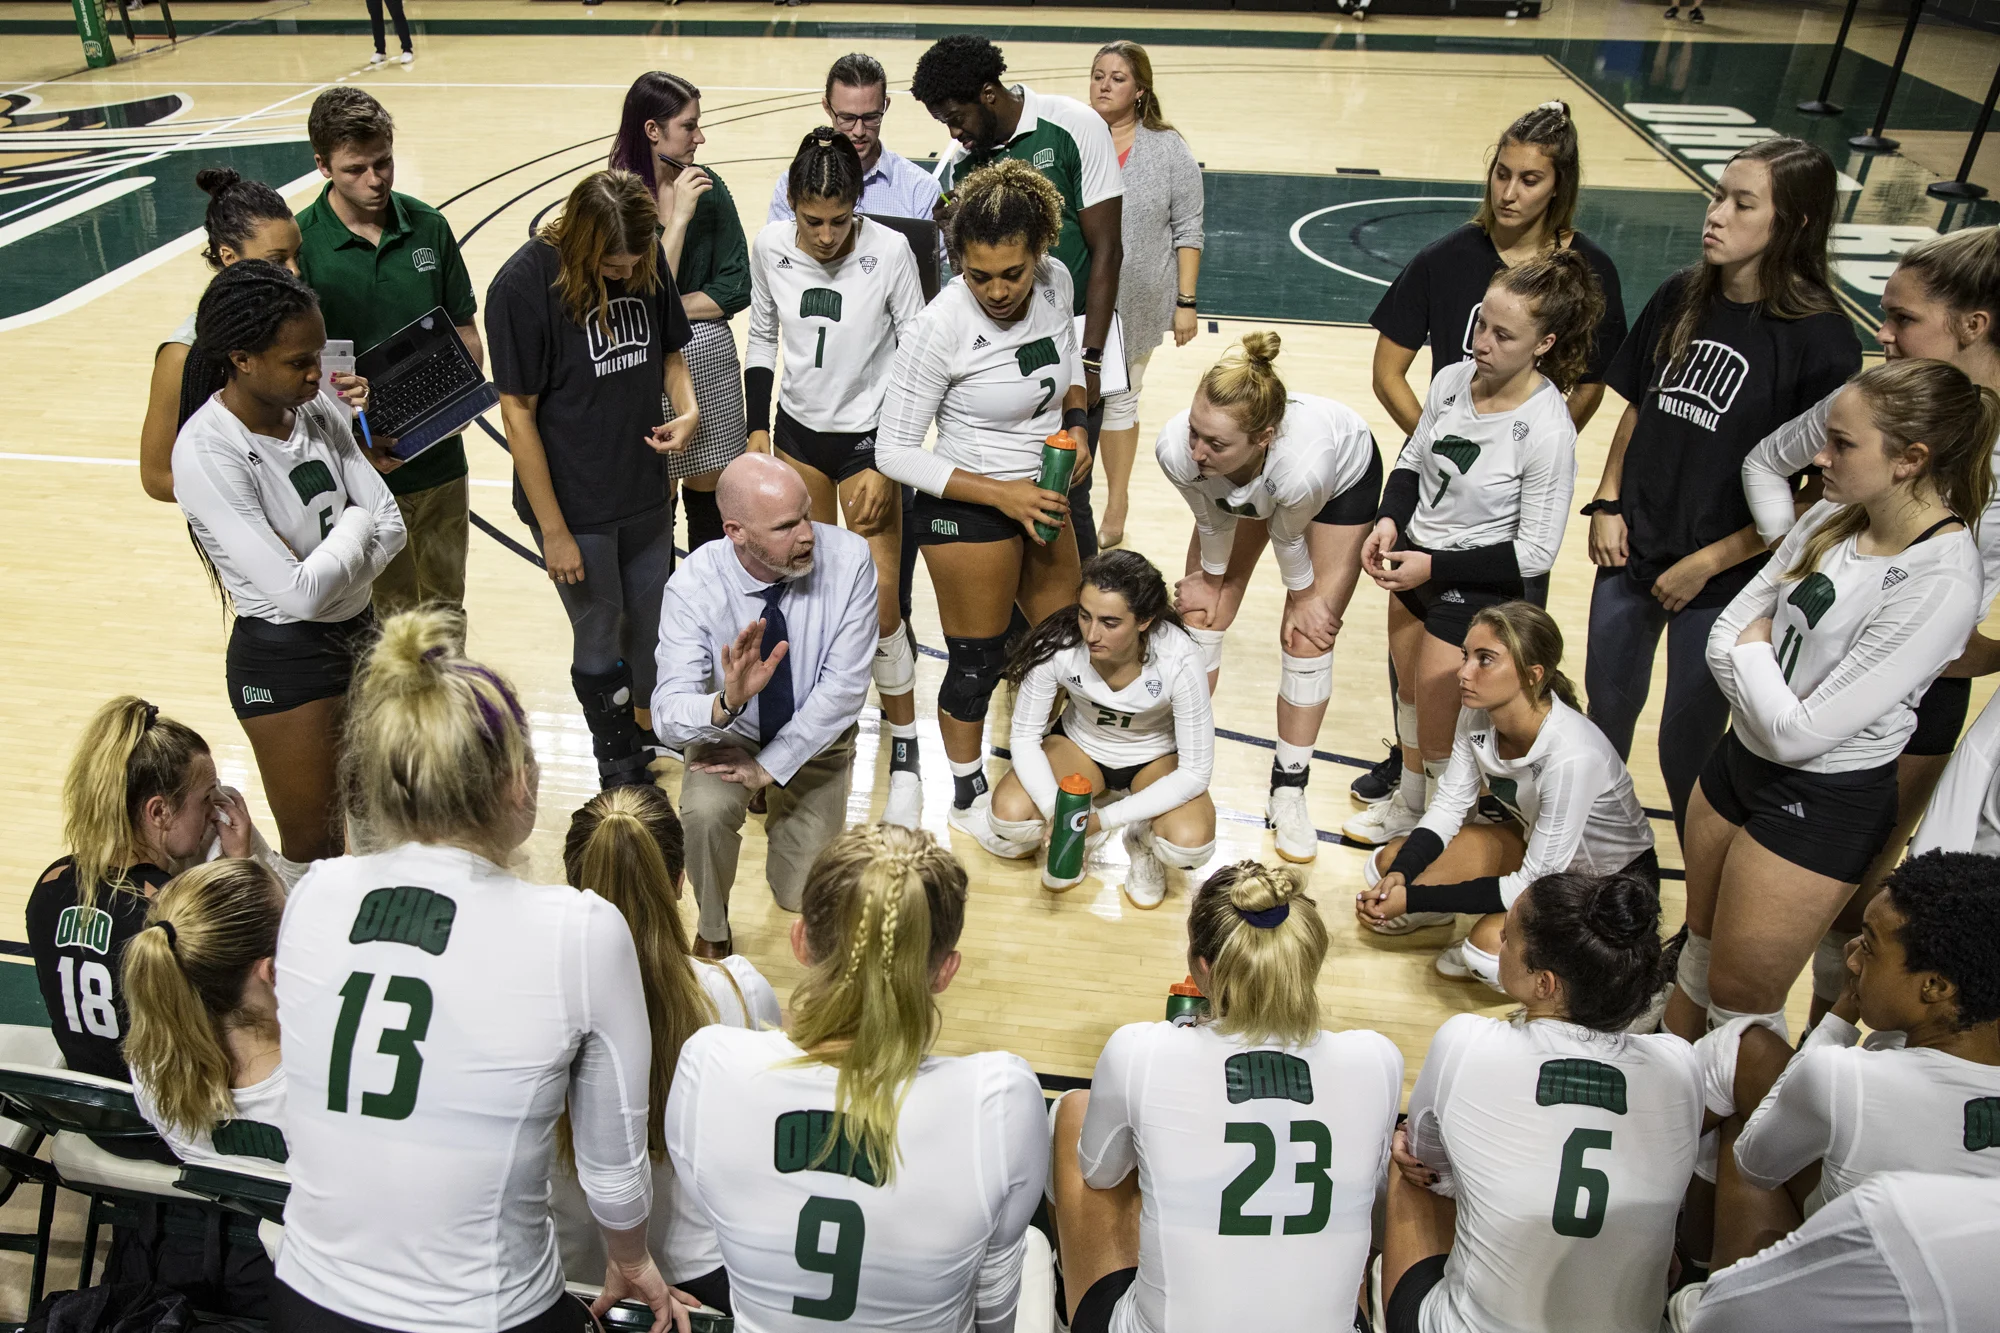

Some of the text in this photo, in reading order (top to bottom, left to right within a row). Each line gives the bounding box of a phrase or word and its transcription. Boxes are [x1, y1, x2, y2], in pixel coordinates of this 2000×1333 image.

[1033, 147, 1054, 166] OHIO
[412, 248, 435, 268] OHIO
[586, 297, 650, 361] OHIO
[815, 327, 826, 368] 1
[972, 341, 991, 351] adidas
[595, 348, 647, 378] VOLLEYBALL
[1659, 340, 1749, 413] OHIO
[1031, 377, 1056, 419] 2
[1658, 394, 1720, 432] VOLLEYBALL
[1431, 469, 1451, 509] 7
[932, 519, 959, 535] OHIO
[1441, 595, 1465, 603] adidas
[1778, 624, 1803, 685] 11
[1096, 710, 1132, 728] 21
[55, 906, 113, 955] OHIO
[57, 956, 120, 1039] 18
[327, 971, 433, 1120] 13
[1224, 1050, 1314, 1105] OHIO
[1218, 1120, 1333, 1236] 23
[1552, 1128, 1612, 1238] 6
[792, 1195, 865, 1321] 9
